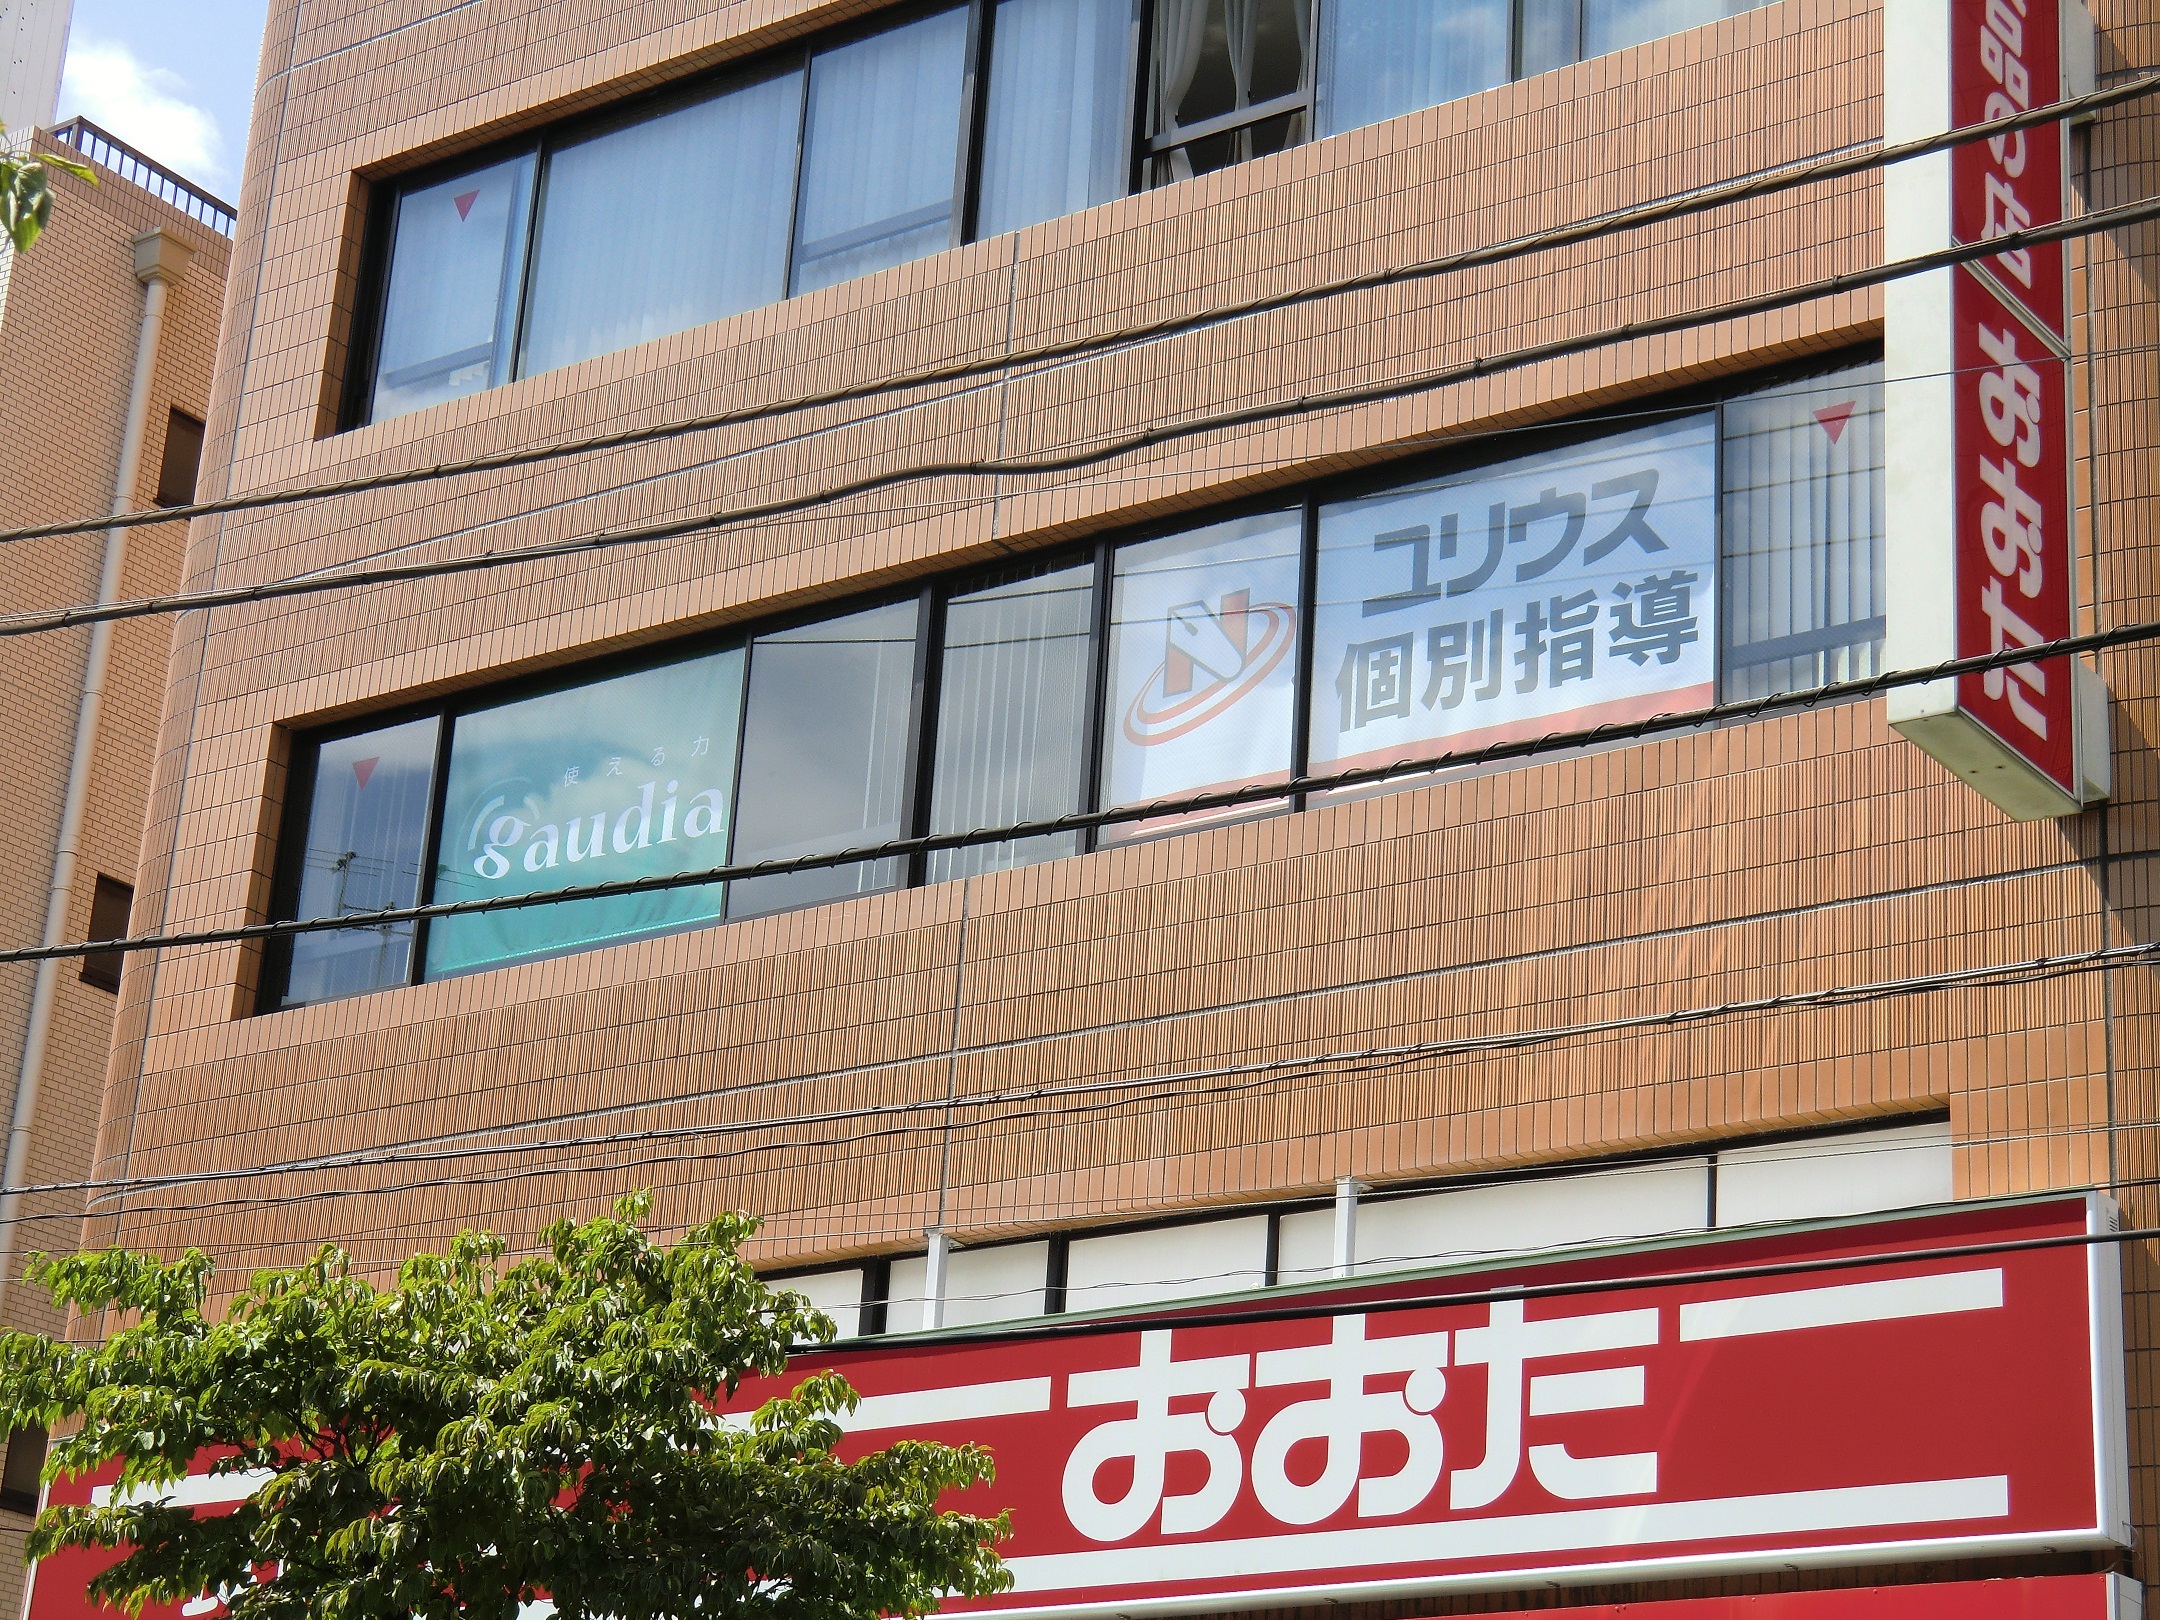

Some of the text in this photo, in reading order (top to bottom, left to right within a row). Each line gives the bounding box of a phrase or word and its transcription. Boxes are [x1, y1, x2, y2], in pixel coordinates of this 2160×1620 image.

[1981, 0, 2031, 289] 品の店
[1362, 468, 1669, 617] ユリウス
[1336, 570, 1698, 732] 個別指導
[473, 779, 724, 879] gaudia
[564, 735, 709, 787] 使える力
[1062, 1286, 1660, 1542] おおた
